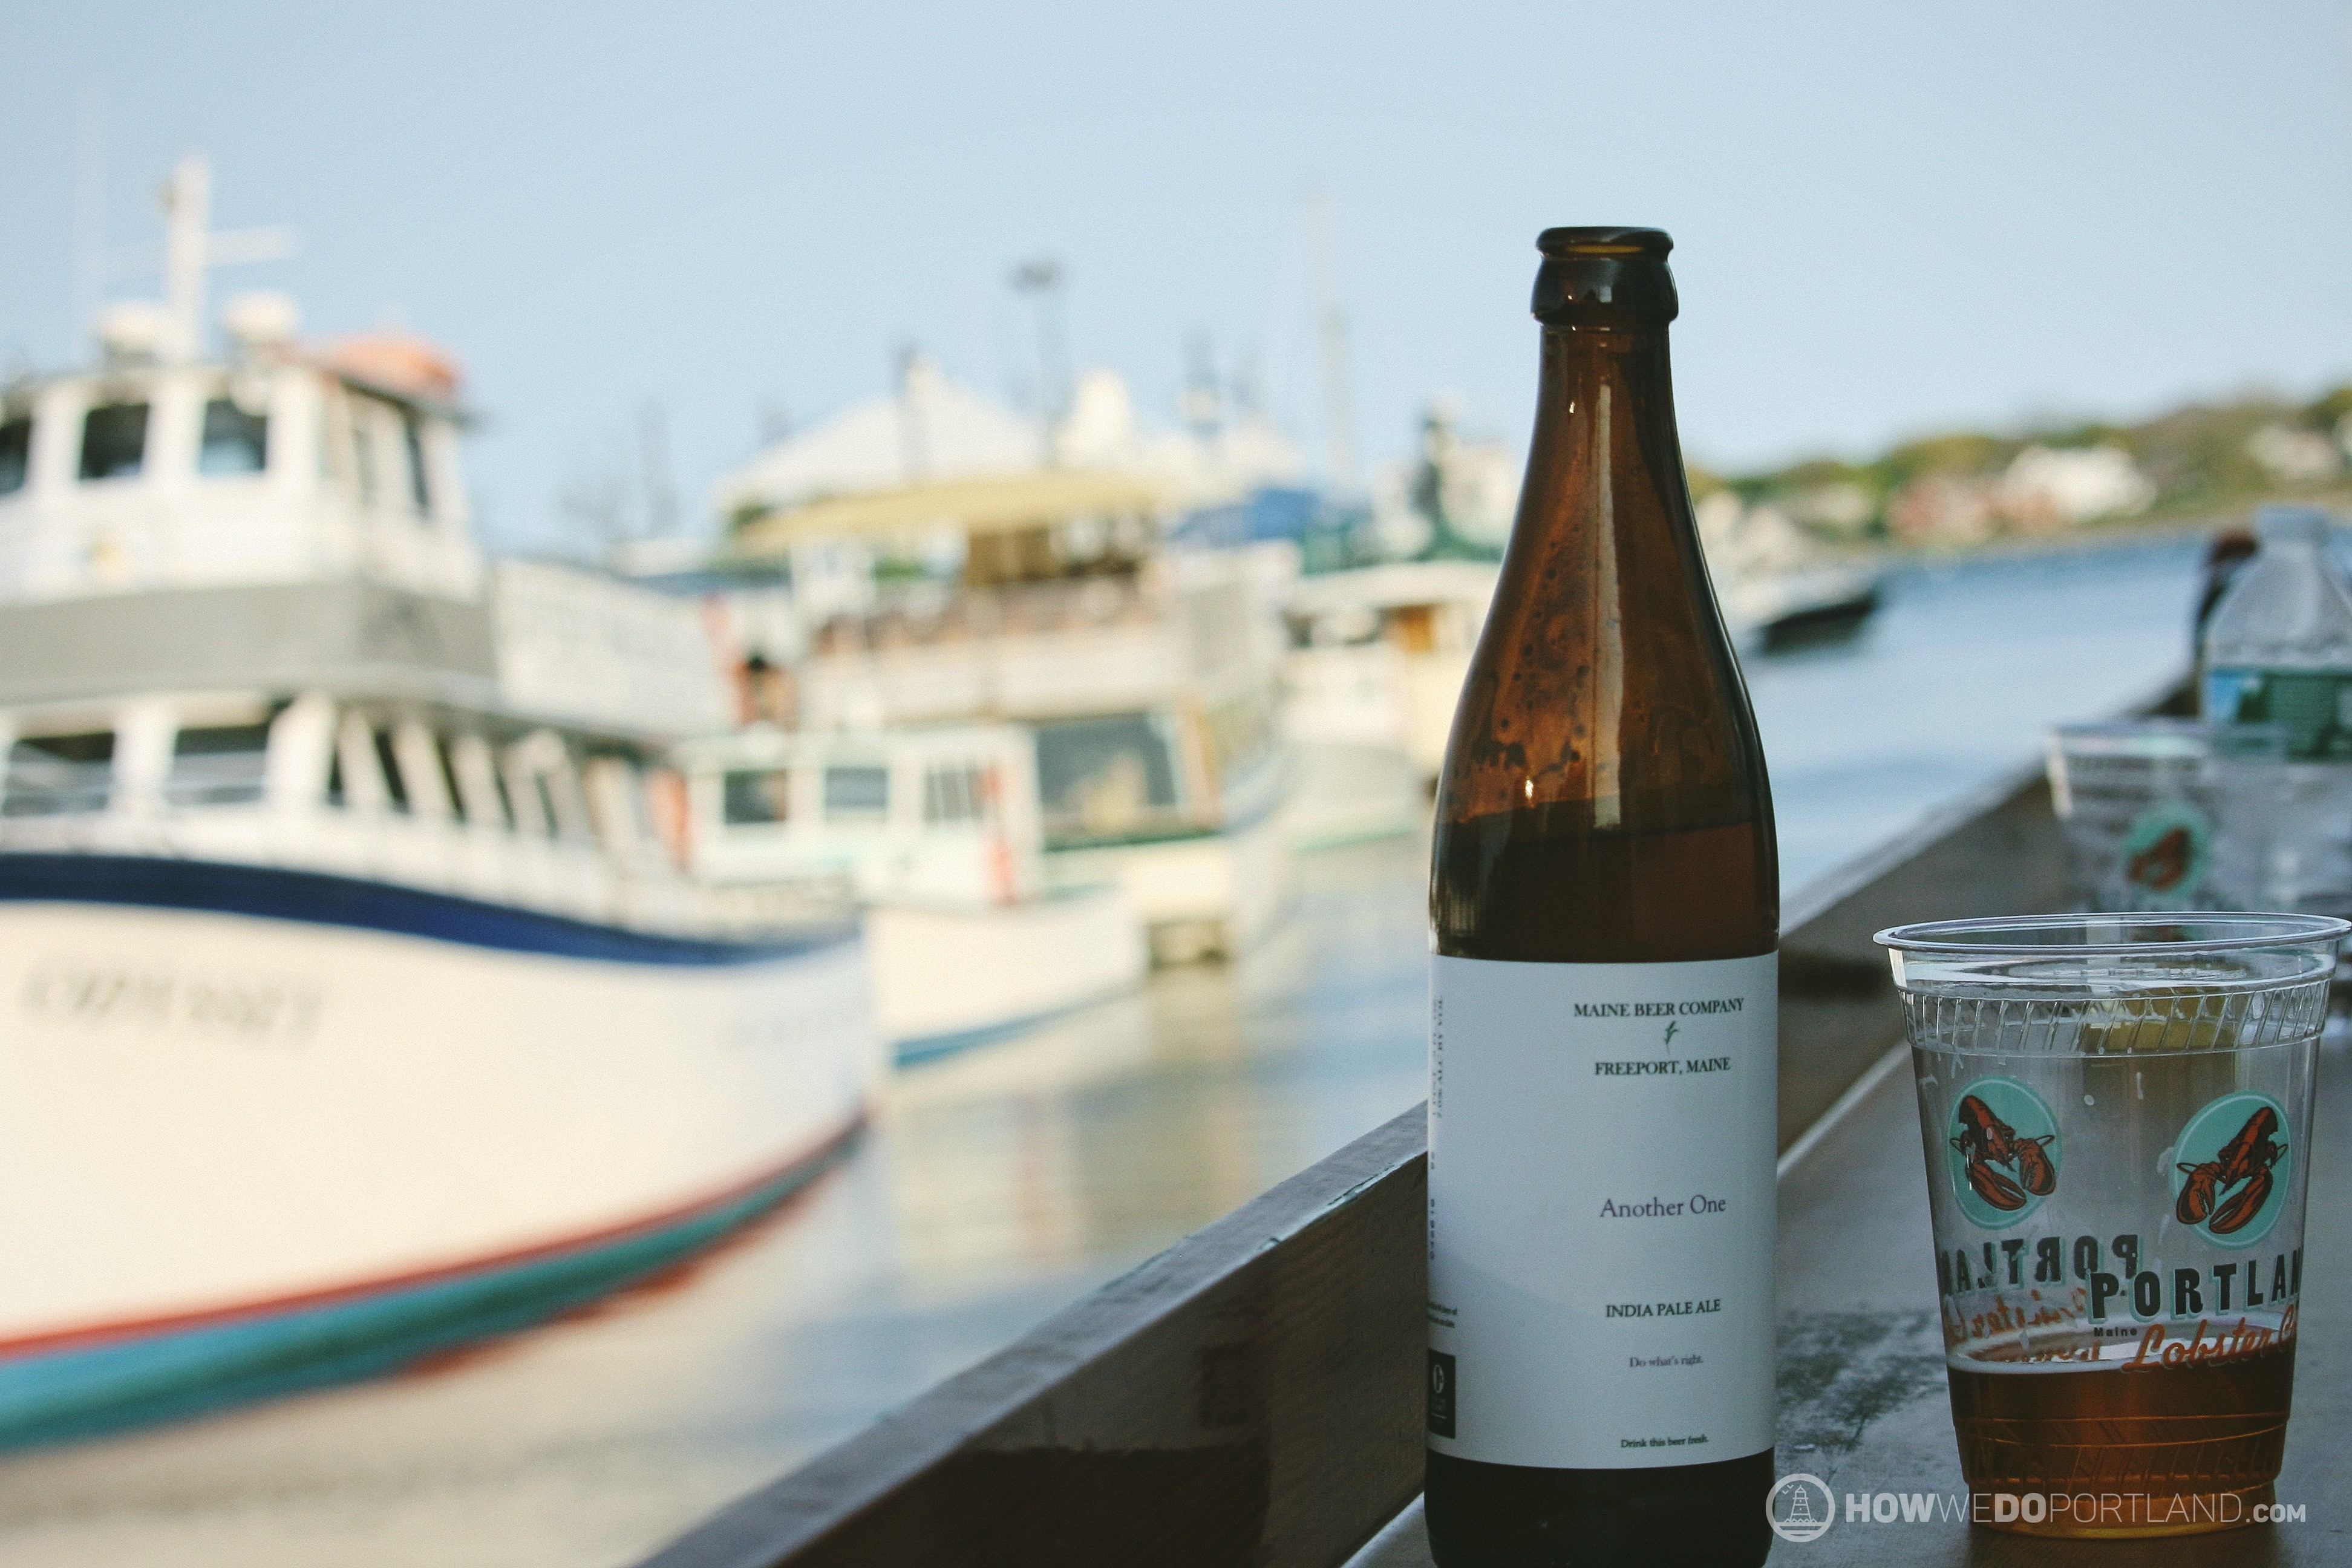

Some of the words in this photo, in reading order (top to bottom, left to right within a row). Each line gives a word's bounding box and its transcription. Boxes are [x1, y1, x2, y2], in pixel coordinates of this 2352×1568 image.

[1574, 1003, 1630, 1017] MAINE
[1635, 1002, 1676, 1016] BEER
[1679, 998, 1745, 1015] COMPANY
[1595, 1060, 1683, 1076] FREEPORT,
[1686, 1057, 1731, 1073] MAINE
[1599, 1197, 1685, 1218] Another
[1690, 1194, 1726, 1215] One
[2088, 1247, 2300, 1321] PORTLAN
[1606, 1304, 1653, 1318] INDIA
[1656, 1301, 1693, 1316] PALE
[1696, 1298, 1722, 1313] ALE
[2094, 1326, 2138, 1338] Maine
[2120, 1318, 2276, 1373] Lobster
[1629, 1356, 1646, 1367] Do
[1649, 1355, 1679, 1367] what's
[1621, 1438, 1647, 1448] Drink
[1650, 1437, 1665, 1446] this
[1668, 1436, 1686, 1446] beer
